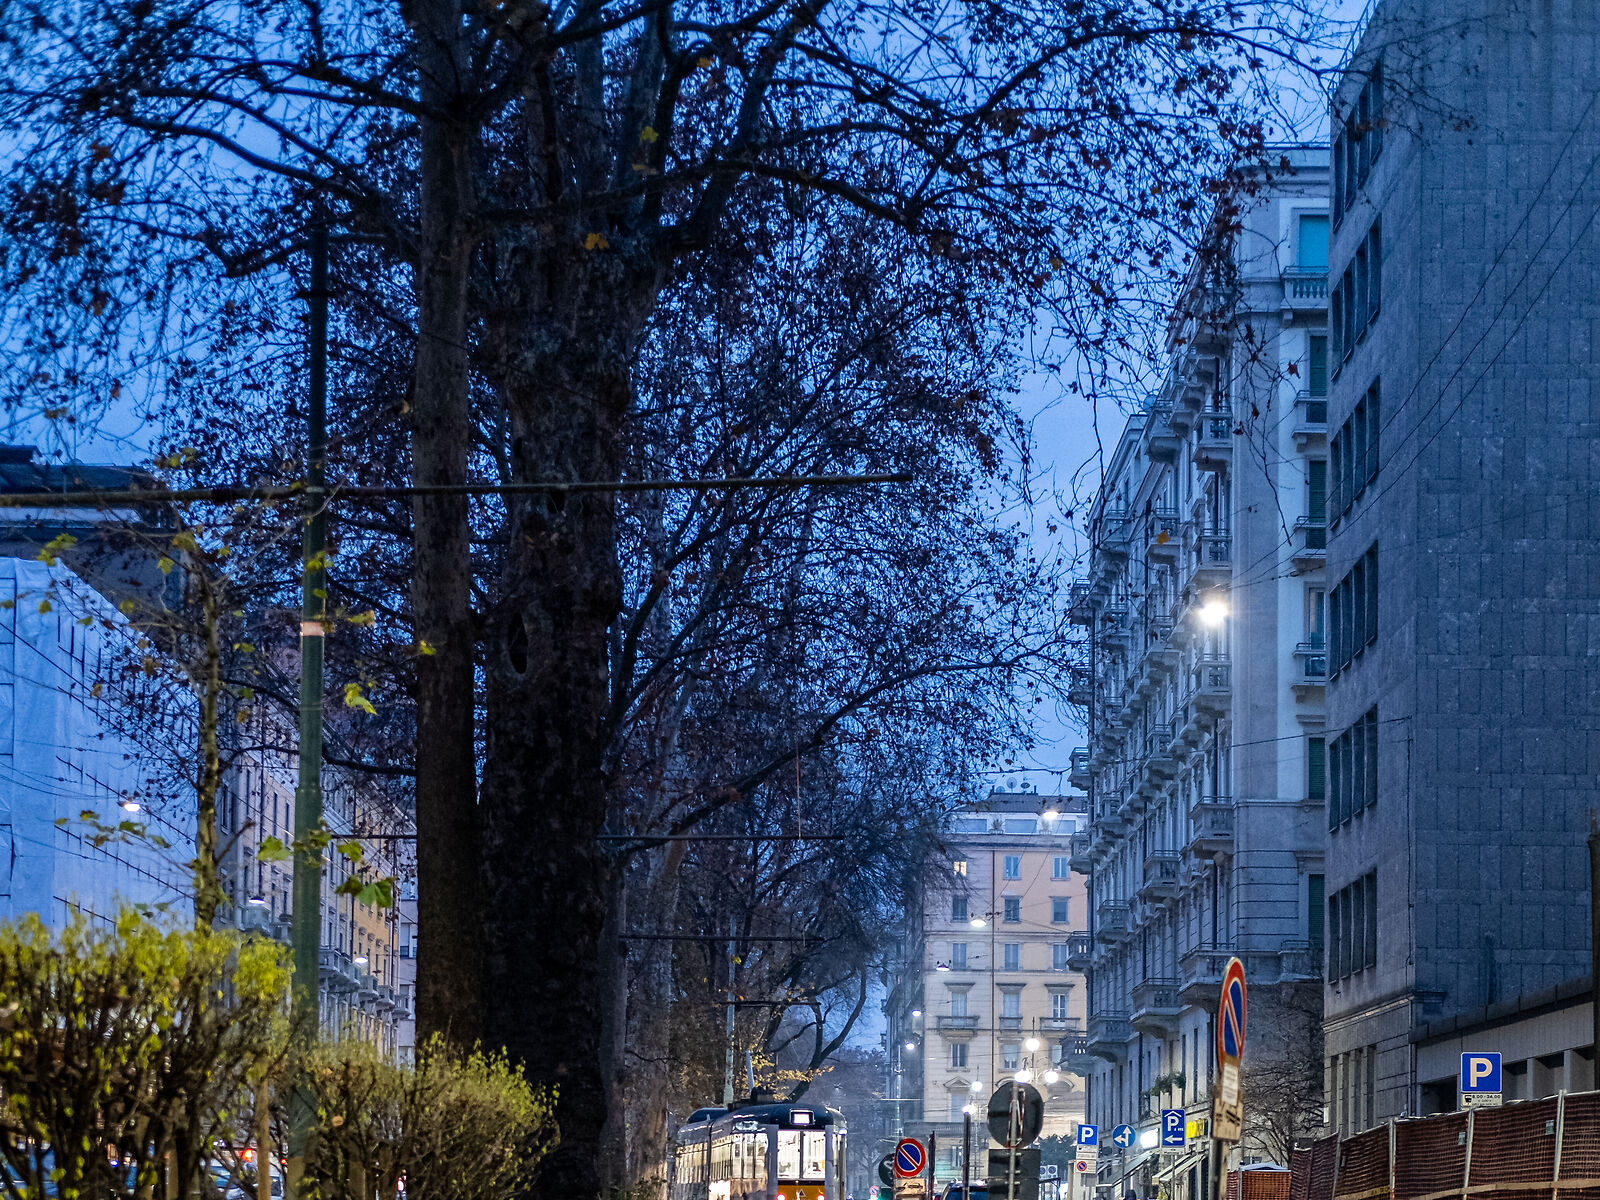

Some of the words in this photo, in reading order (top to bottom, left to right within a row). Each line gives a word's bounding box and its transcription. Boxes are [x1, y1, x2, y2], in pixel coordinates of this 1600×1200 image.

[1470, 1057, 1493, 1088] P
[1167, 1115, 1179, 1131] P
[1081, 1126, 1094, 1143] P
